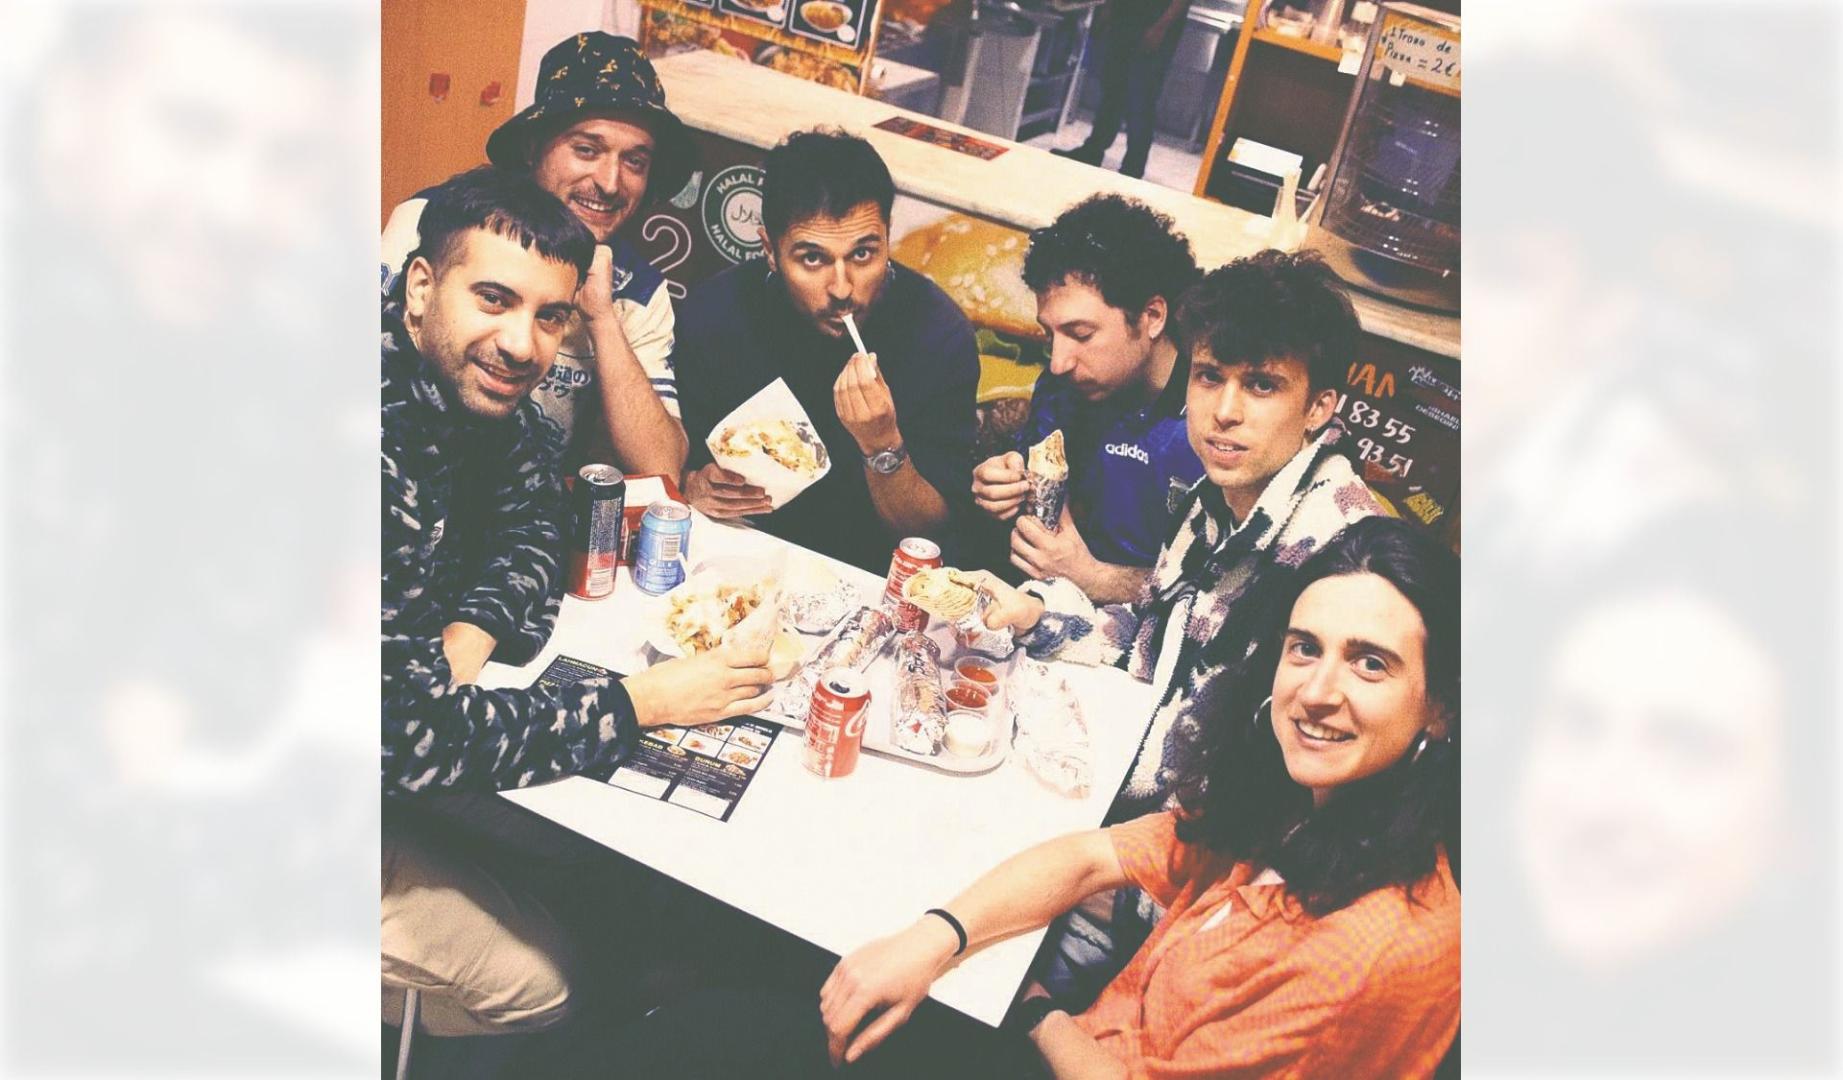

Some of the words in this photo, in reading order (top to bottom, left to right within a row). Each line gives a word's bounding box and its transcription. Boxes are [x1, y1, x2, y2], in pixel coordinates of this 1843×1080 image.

[1436, 41, 1453, 54] de
[716, 173, 755, 194] HALAL
[711, 224, 742, 259] HALAL
[1349, 400, 1381, 428] 83
[1382, 417, 1416, 444] 55
[1105, 443, 1149, 464] adidas
[1357, 437, 1384, 463] 93
[1385, 453, 1414, 478] 51
